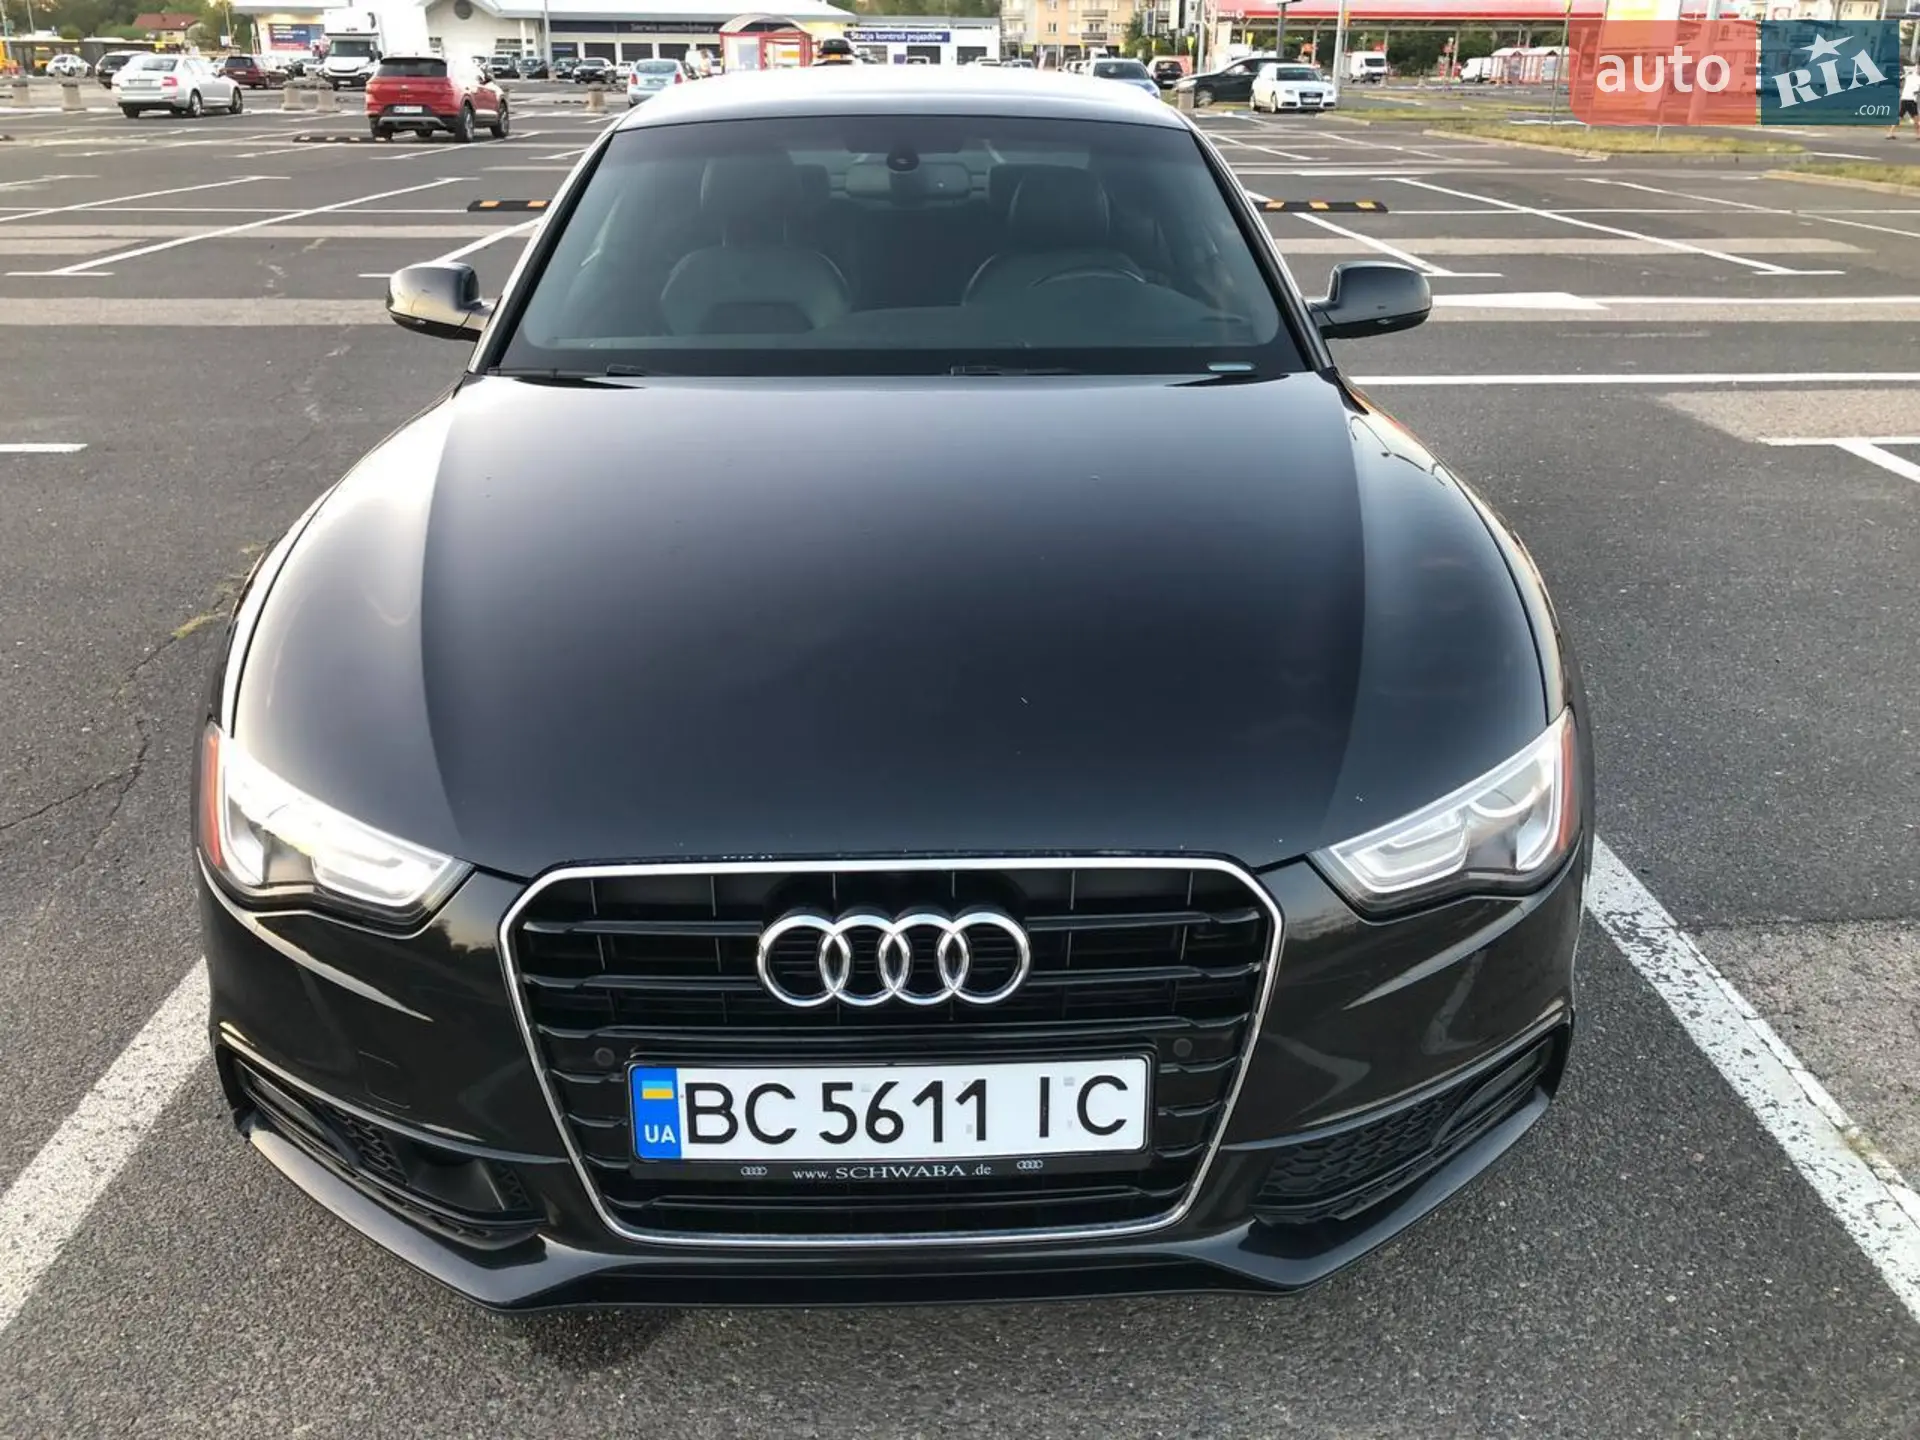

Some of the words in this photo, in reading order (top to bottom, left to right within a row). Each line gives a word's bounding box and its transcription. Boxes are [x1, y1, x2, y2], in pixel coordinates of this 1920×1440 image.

[685, 1082, 798, 1145] BC
[819, 1078, 987, 1145] 5611
[1039, 1074, 1129, 1137] IC
[644, 1123, 677, 1144] UA
